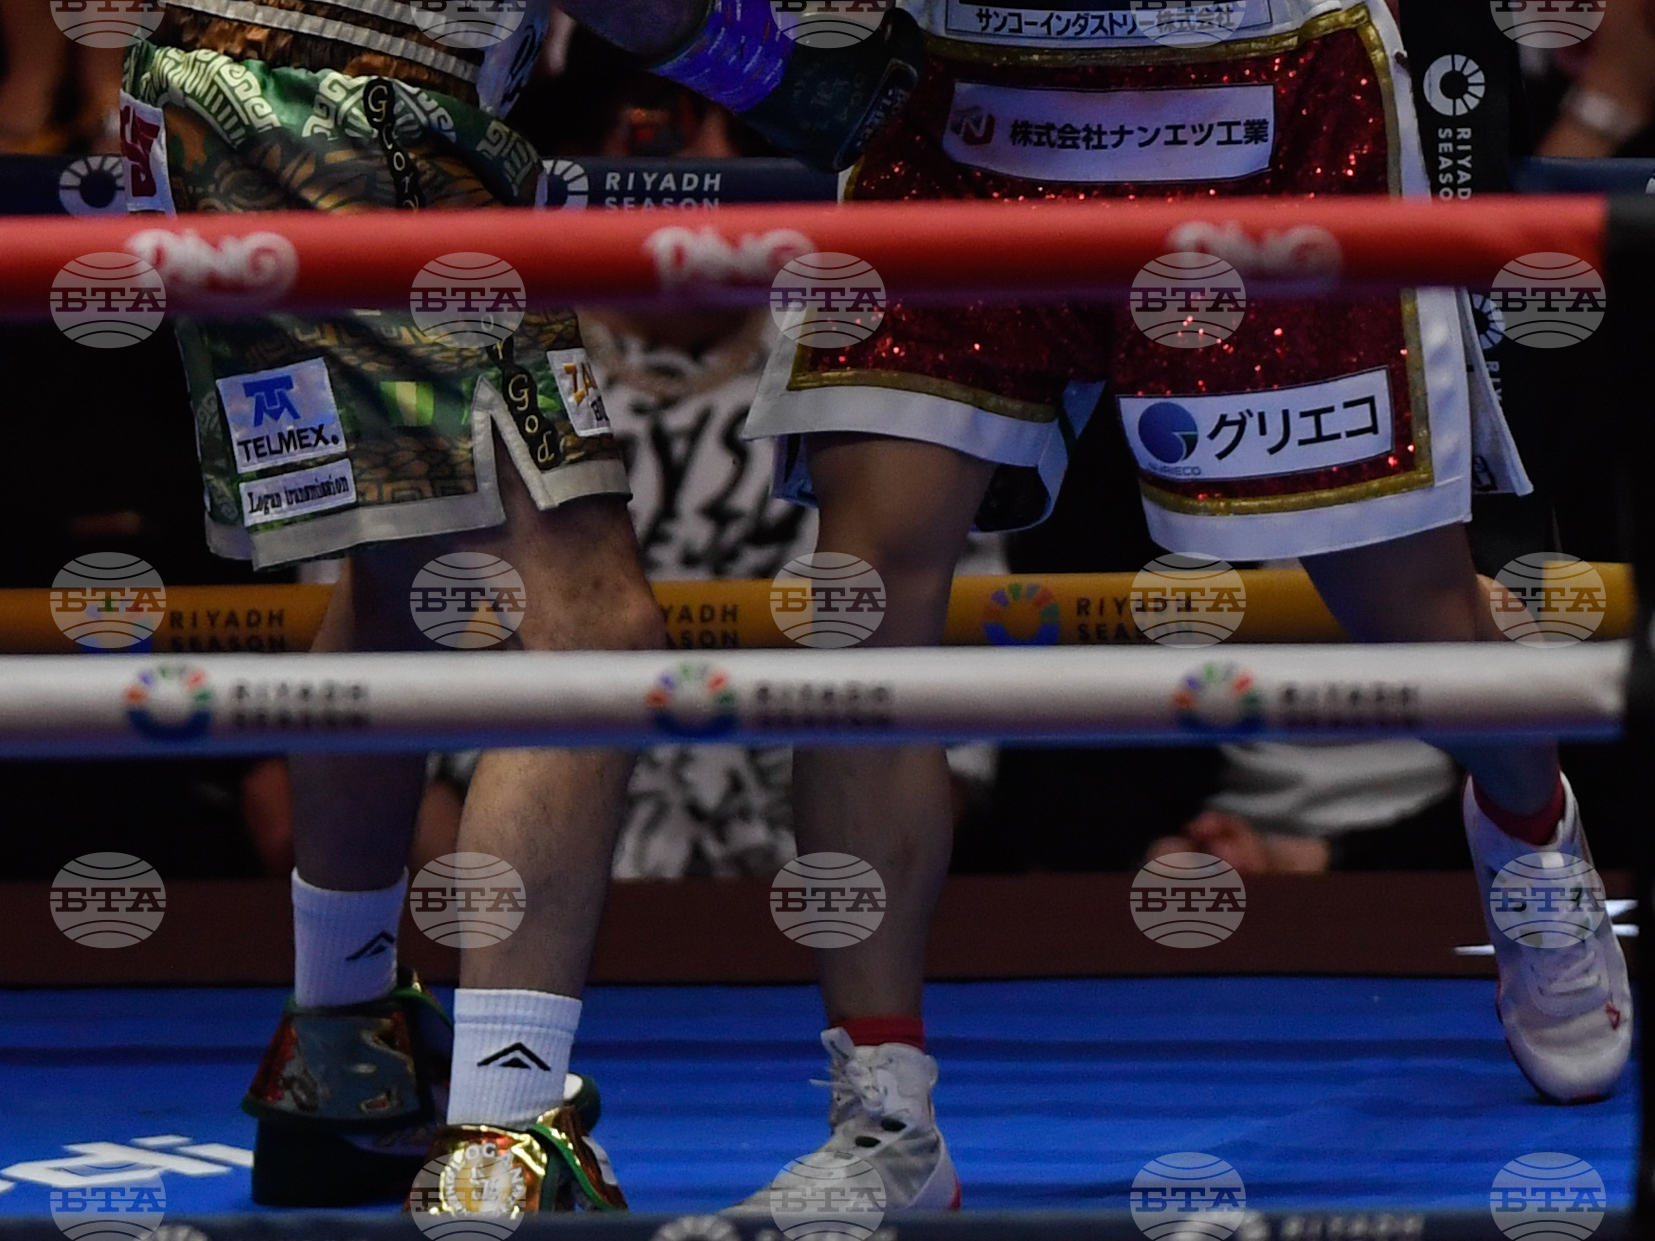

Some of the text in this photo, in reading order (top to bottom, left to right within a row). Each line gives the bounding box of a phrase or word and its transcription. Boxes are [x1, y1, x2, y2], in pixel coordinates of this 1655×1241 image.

[1009, 119, 1270, 150] 株式会社ナンエツ工業
[1438, 127, 1454, 202] SEASO
[1456, 127, 1472, 201] RIYAD
[604, 171, 722, 192] RIYADH
[508, 373, 556, 463] God
[1207, 395, 1379, 460] グリエコ
